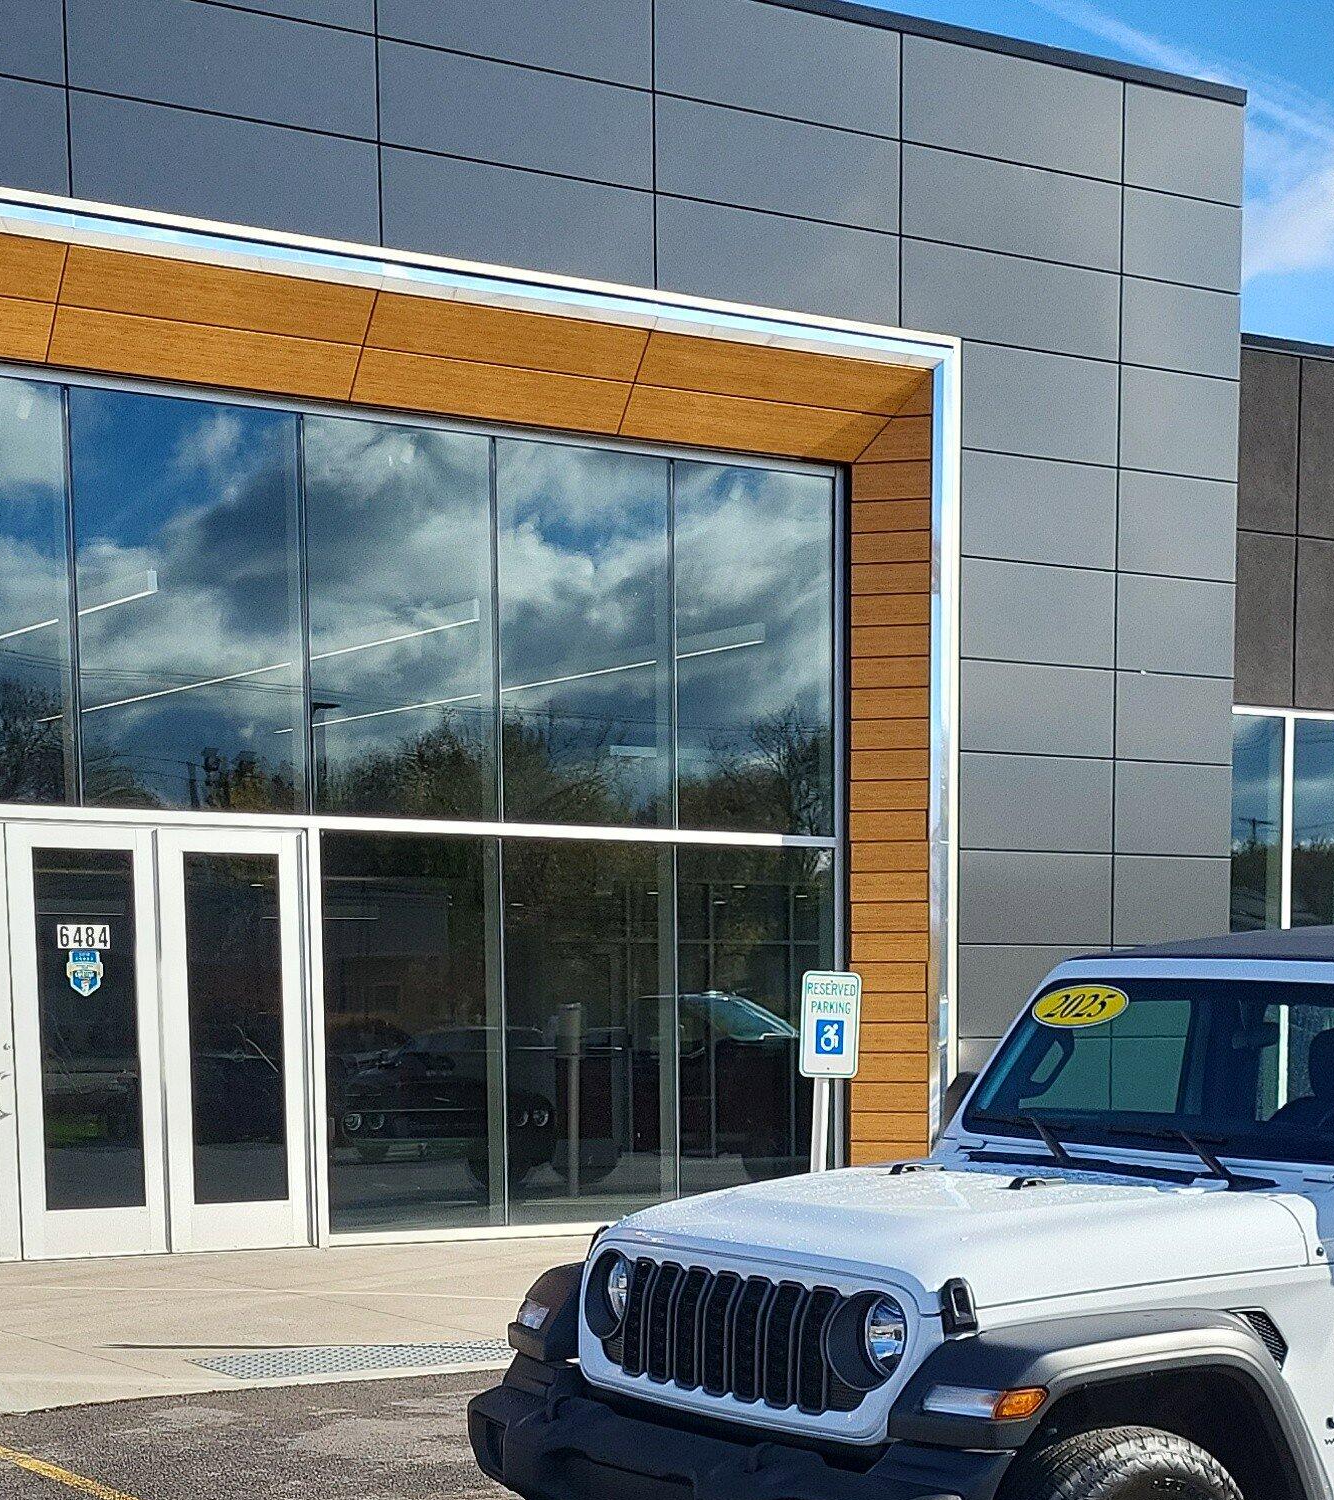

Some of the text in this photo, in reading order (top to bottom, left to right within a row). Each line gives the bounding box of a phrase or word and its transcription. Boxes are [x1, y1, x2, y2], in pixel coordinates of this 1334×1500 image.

[59, 925, 109, 948] 6484
[807, 982, 856, 997] RESERVED
[810, 1000, 852, 1015] PARKING
[1043, 993, 1118, 1019] 2025
